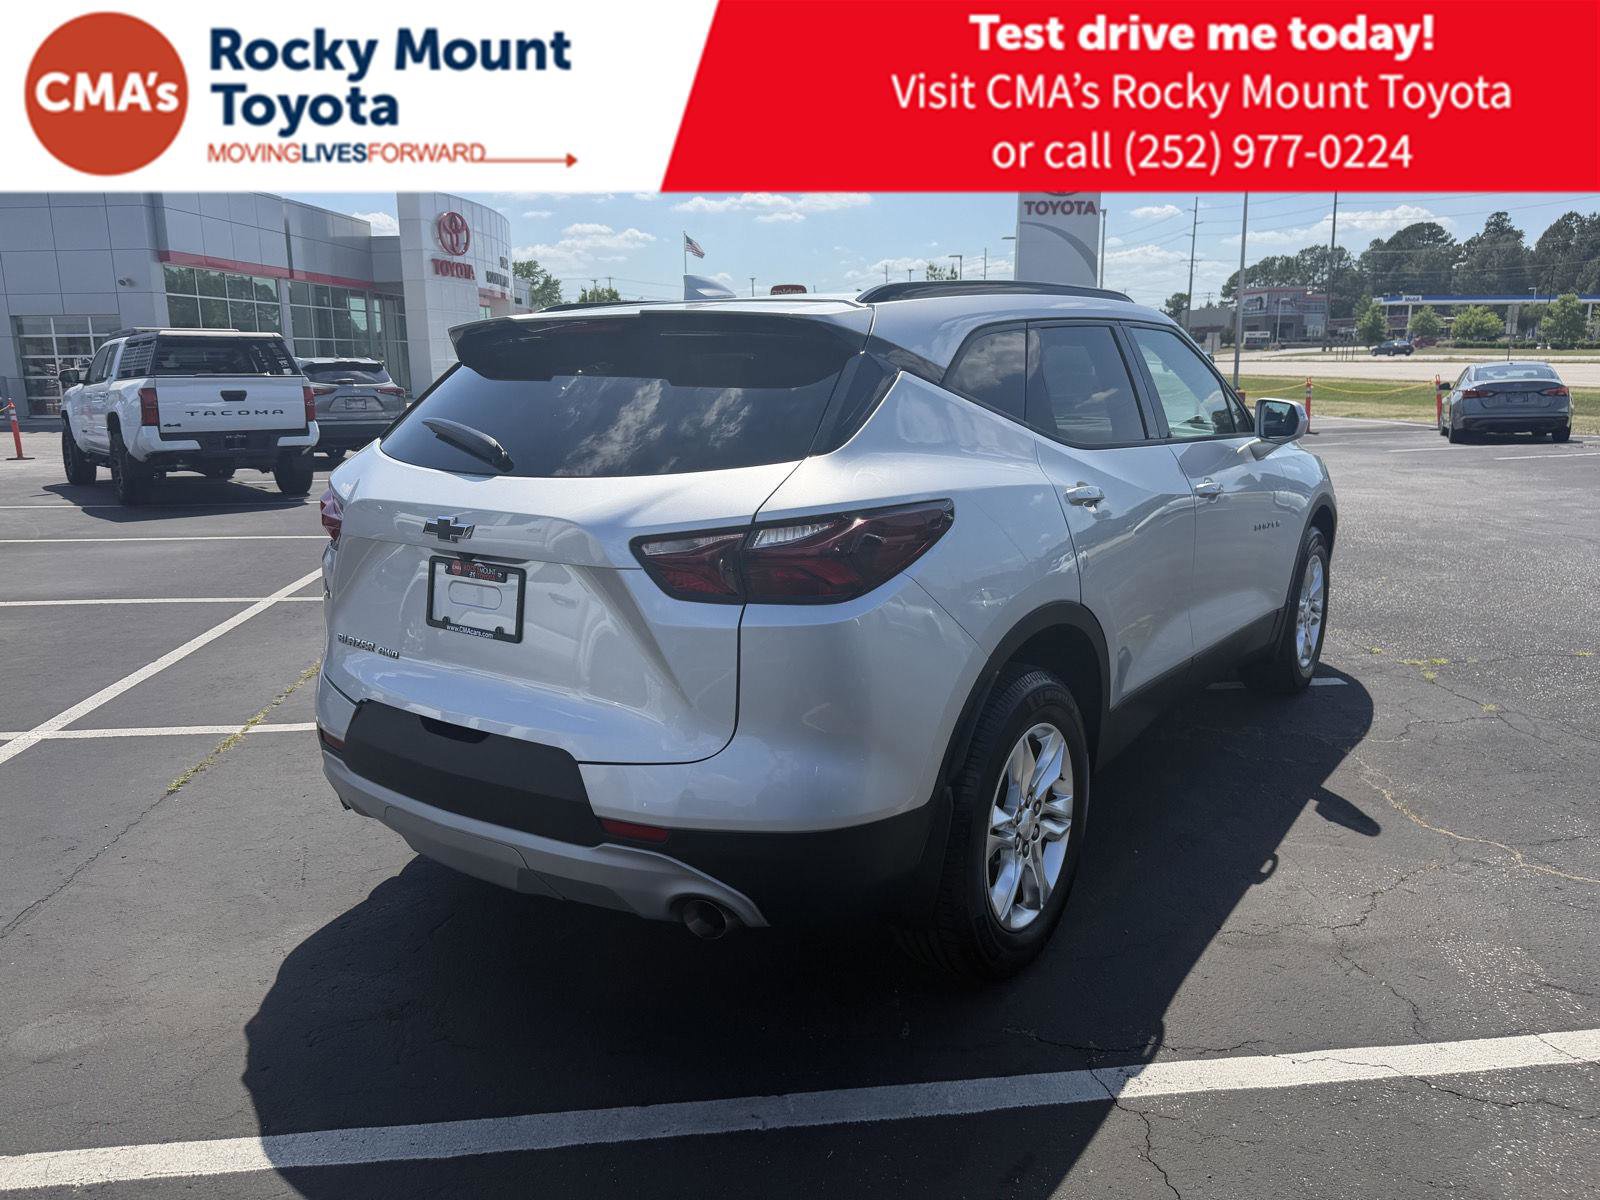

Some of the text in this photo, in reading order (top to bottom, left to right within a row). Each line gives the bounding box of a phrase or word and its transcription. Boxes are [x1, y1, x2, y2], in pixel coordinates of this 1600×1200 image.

[1023, 200, 1098, 216] TOYOTA
[431, 258, 475, 280] TOYOTA
[184, 409, 285, 417] TACOMA
[337, 632, 376, 653] BLAZER
